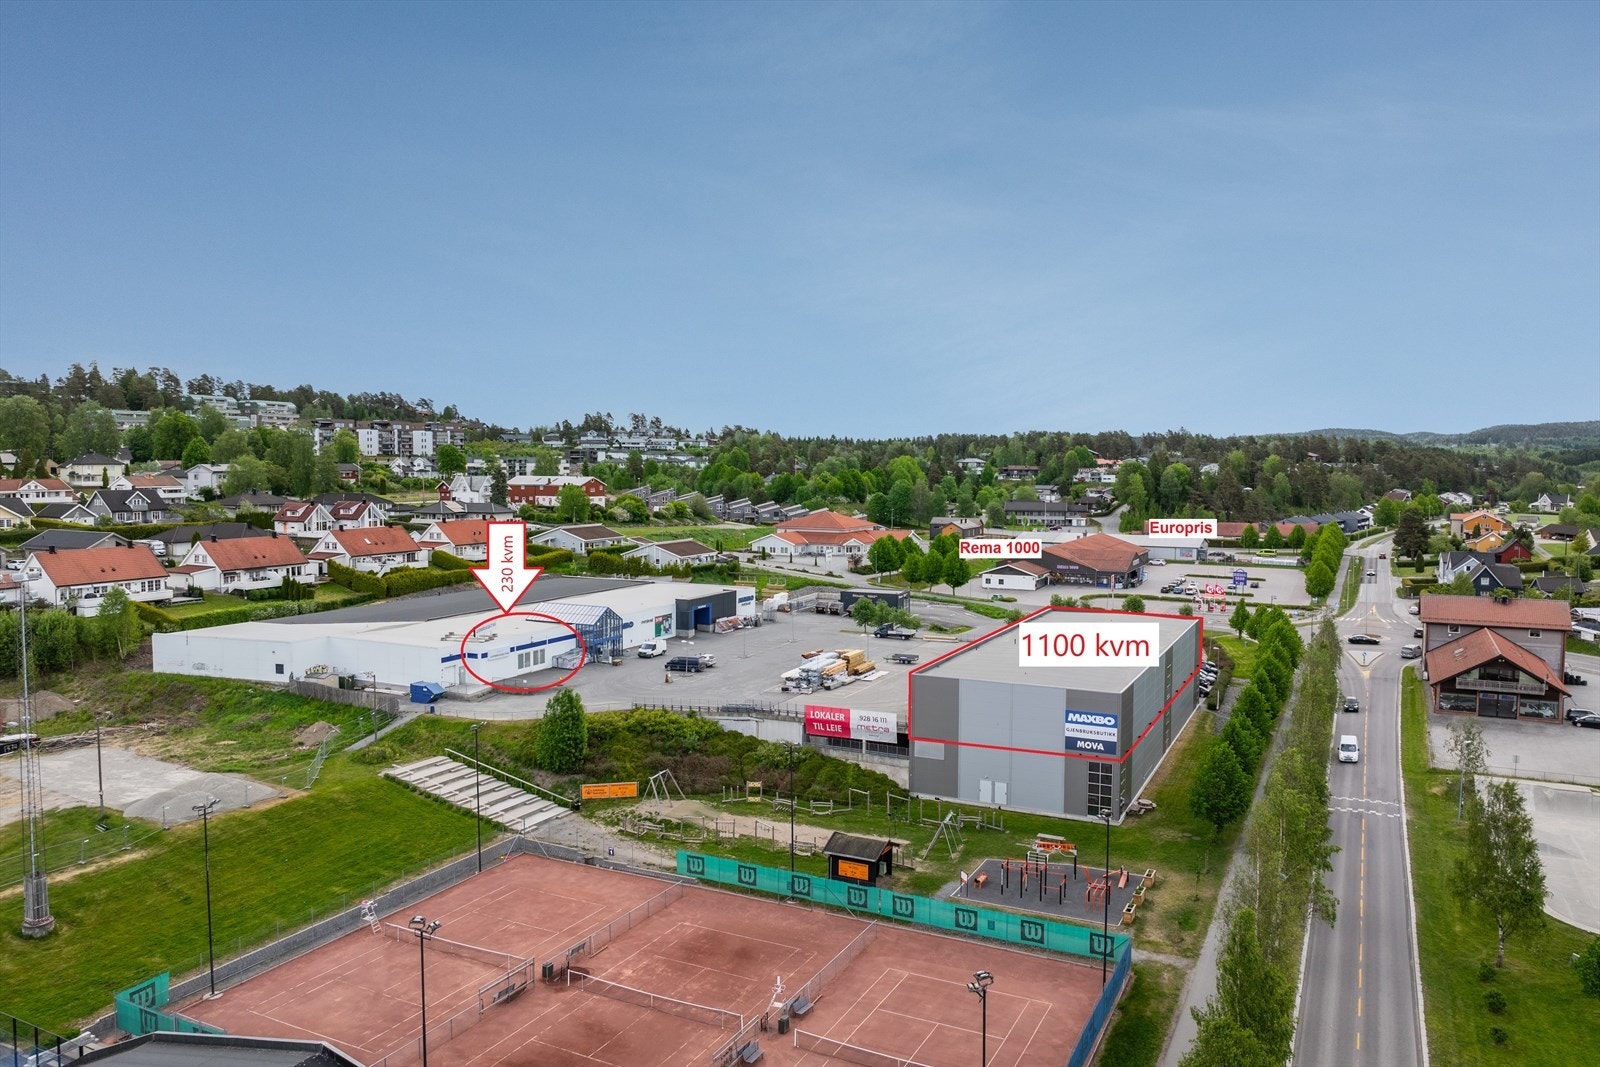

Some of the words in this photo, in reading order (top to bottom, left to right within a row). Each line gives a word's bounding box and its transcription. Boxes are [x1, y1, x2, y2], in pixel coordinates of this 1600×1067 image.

[810, 710, 845, 722] LOKALER
[1067, 712, 1116, 726] MAXBO
[812, 722, 825, 731] TIL
[826, 723, 843, 733] LEIE
[1065, 727, 1117, 737] GJENBRUKSBUTIKK
[1076, 740, 1105, 751] MOVA
